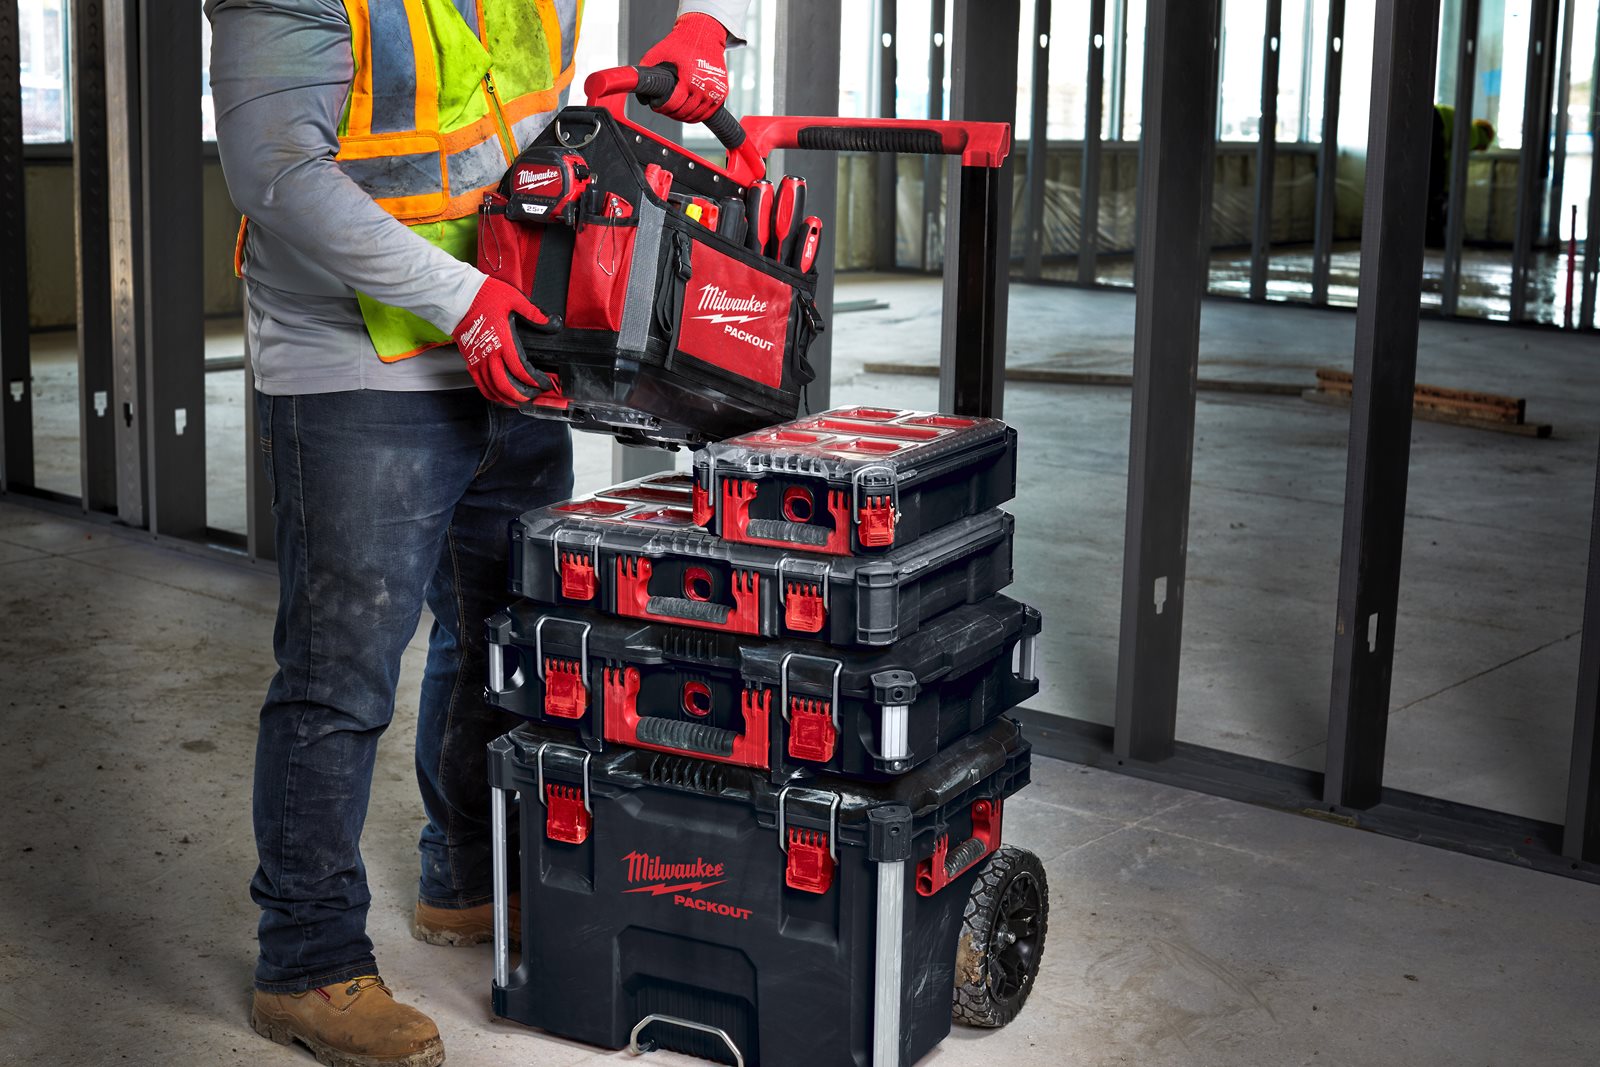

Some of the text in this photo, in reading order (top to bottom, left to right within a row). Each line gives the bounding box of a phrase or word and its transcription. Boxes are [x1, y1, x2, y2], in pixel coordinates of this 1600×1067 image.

[517, 169, 559, 185] Milwaukee
[698, 283, 767, 313] Milwaukee
[724, 324, 774, 351] PACKOUT
[620, 850, 724, 884] Milwaukee
[674, 894, 753, 920] PACKOUT
